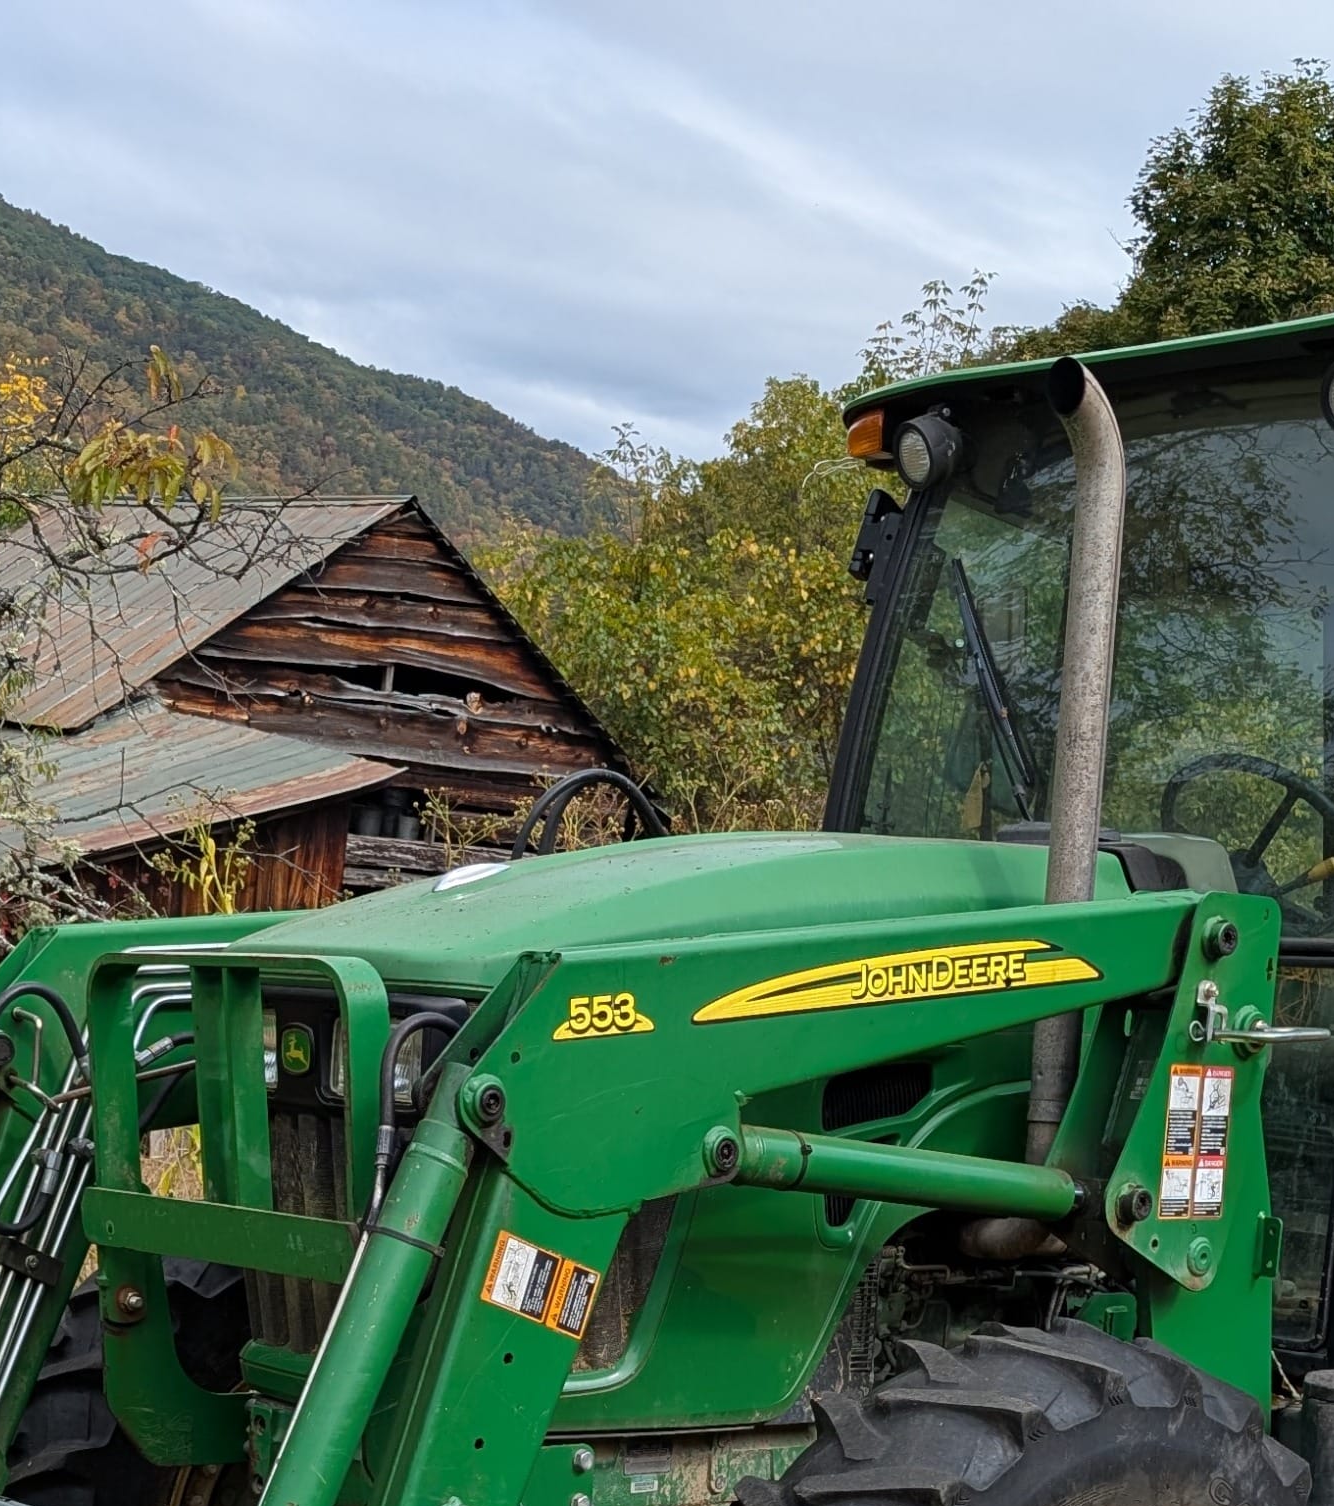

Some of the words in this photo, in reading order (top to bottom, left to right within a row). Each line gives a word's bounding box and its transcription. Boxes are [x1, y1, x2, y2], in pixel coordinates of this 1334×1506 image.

[851, 963, 929, 1000] JOHN
[928, 952, 1026, 990] DEERE
[569, 992, 637, 1032] 553
[1171, 1159, 1192, 1167] WARNING
[1204, 1159, 1223, 1167] DANGER
[488, 1239, 506, 1284] WARNING
[554, 1267, 572, 1310] WARNING
